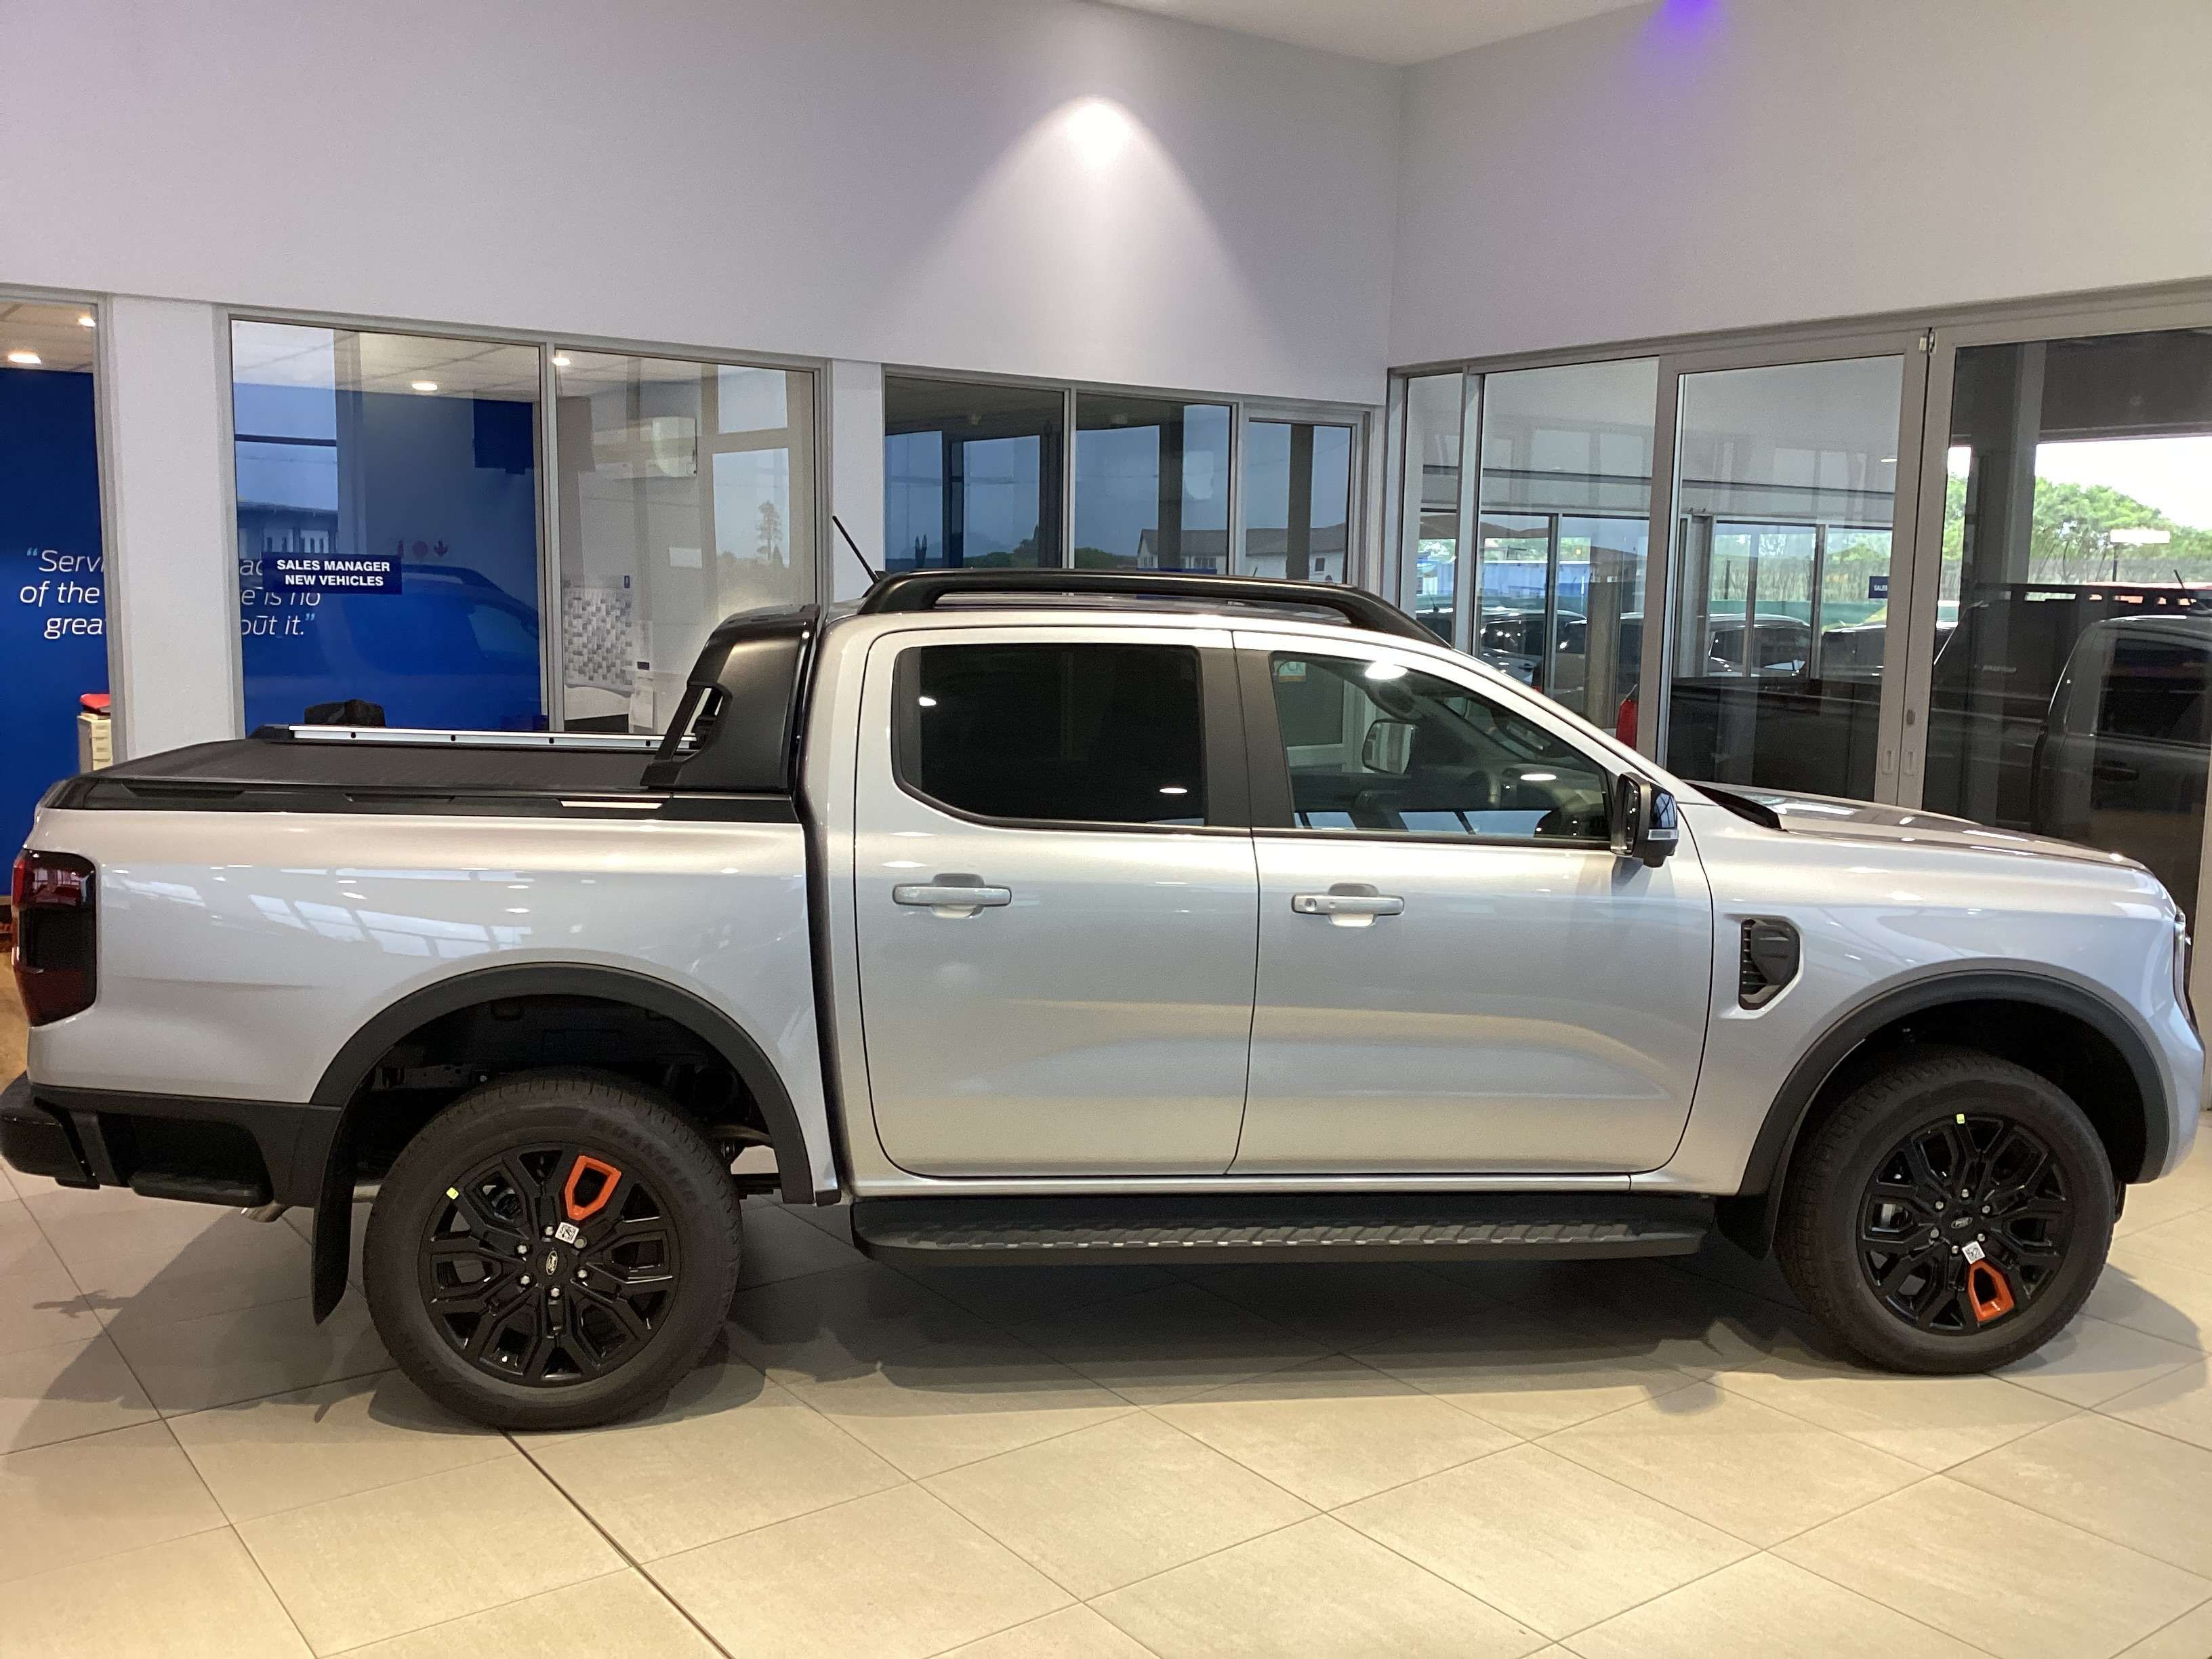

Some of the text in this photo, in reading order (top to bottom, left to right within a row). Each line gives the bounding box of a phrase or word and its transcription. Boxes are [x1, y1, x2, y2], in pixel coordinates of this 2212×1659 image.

[276, 559, 320, 571] SALES
[324, 560, 390, 572] MANAGER
[285, 574, 384, 586] NEW VEHICLES
[20, 580, 51, 607] of
[57, 581, 100, 604] the
[43, 617, 106, 640] grea
